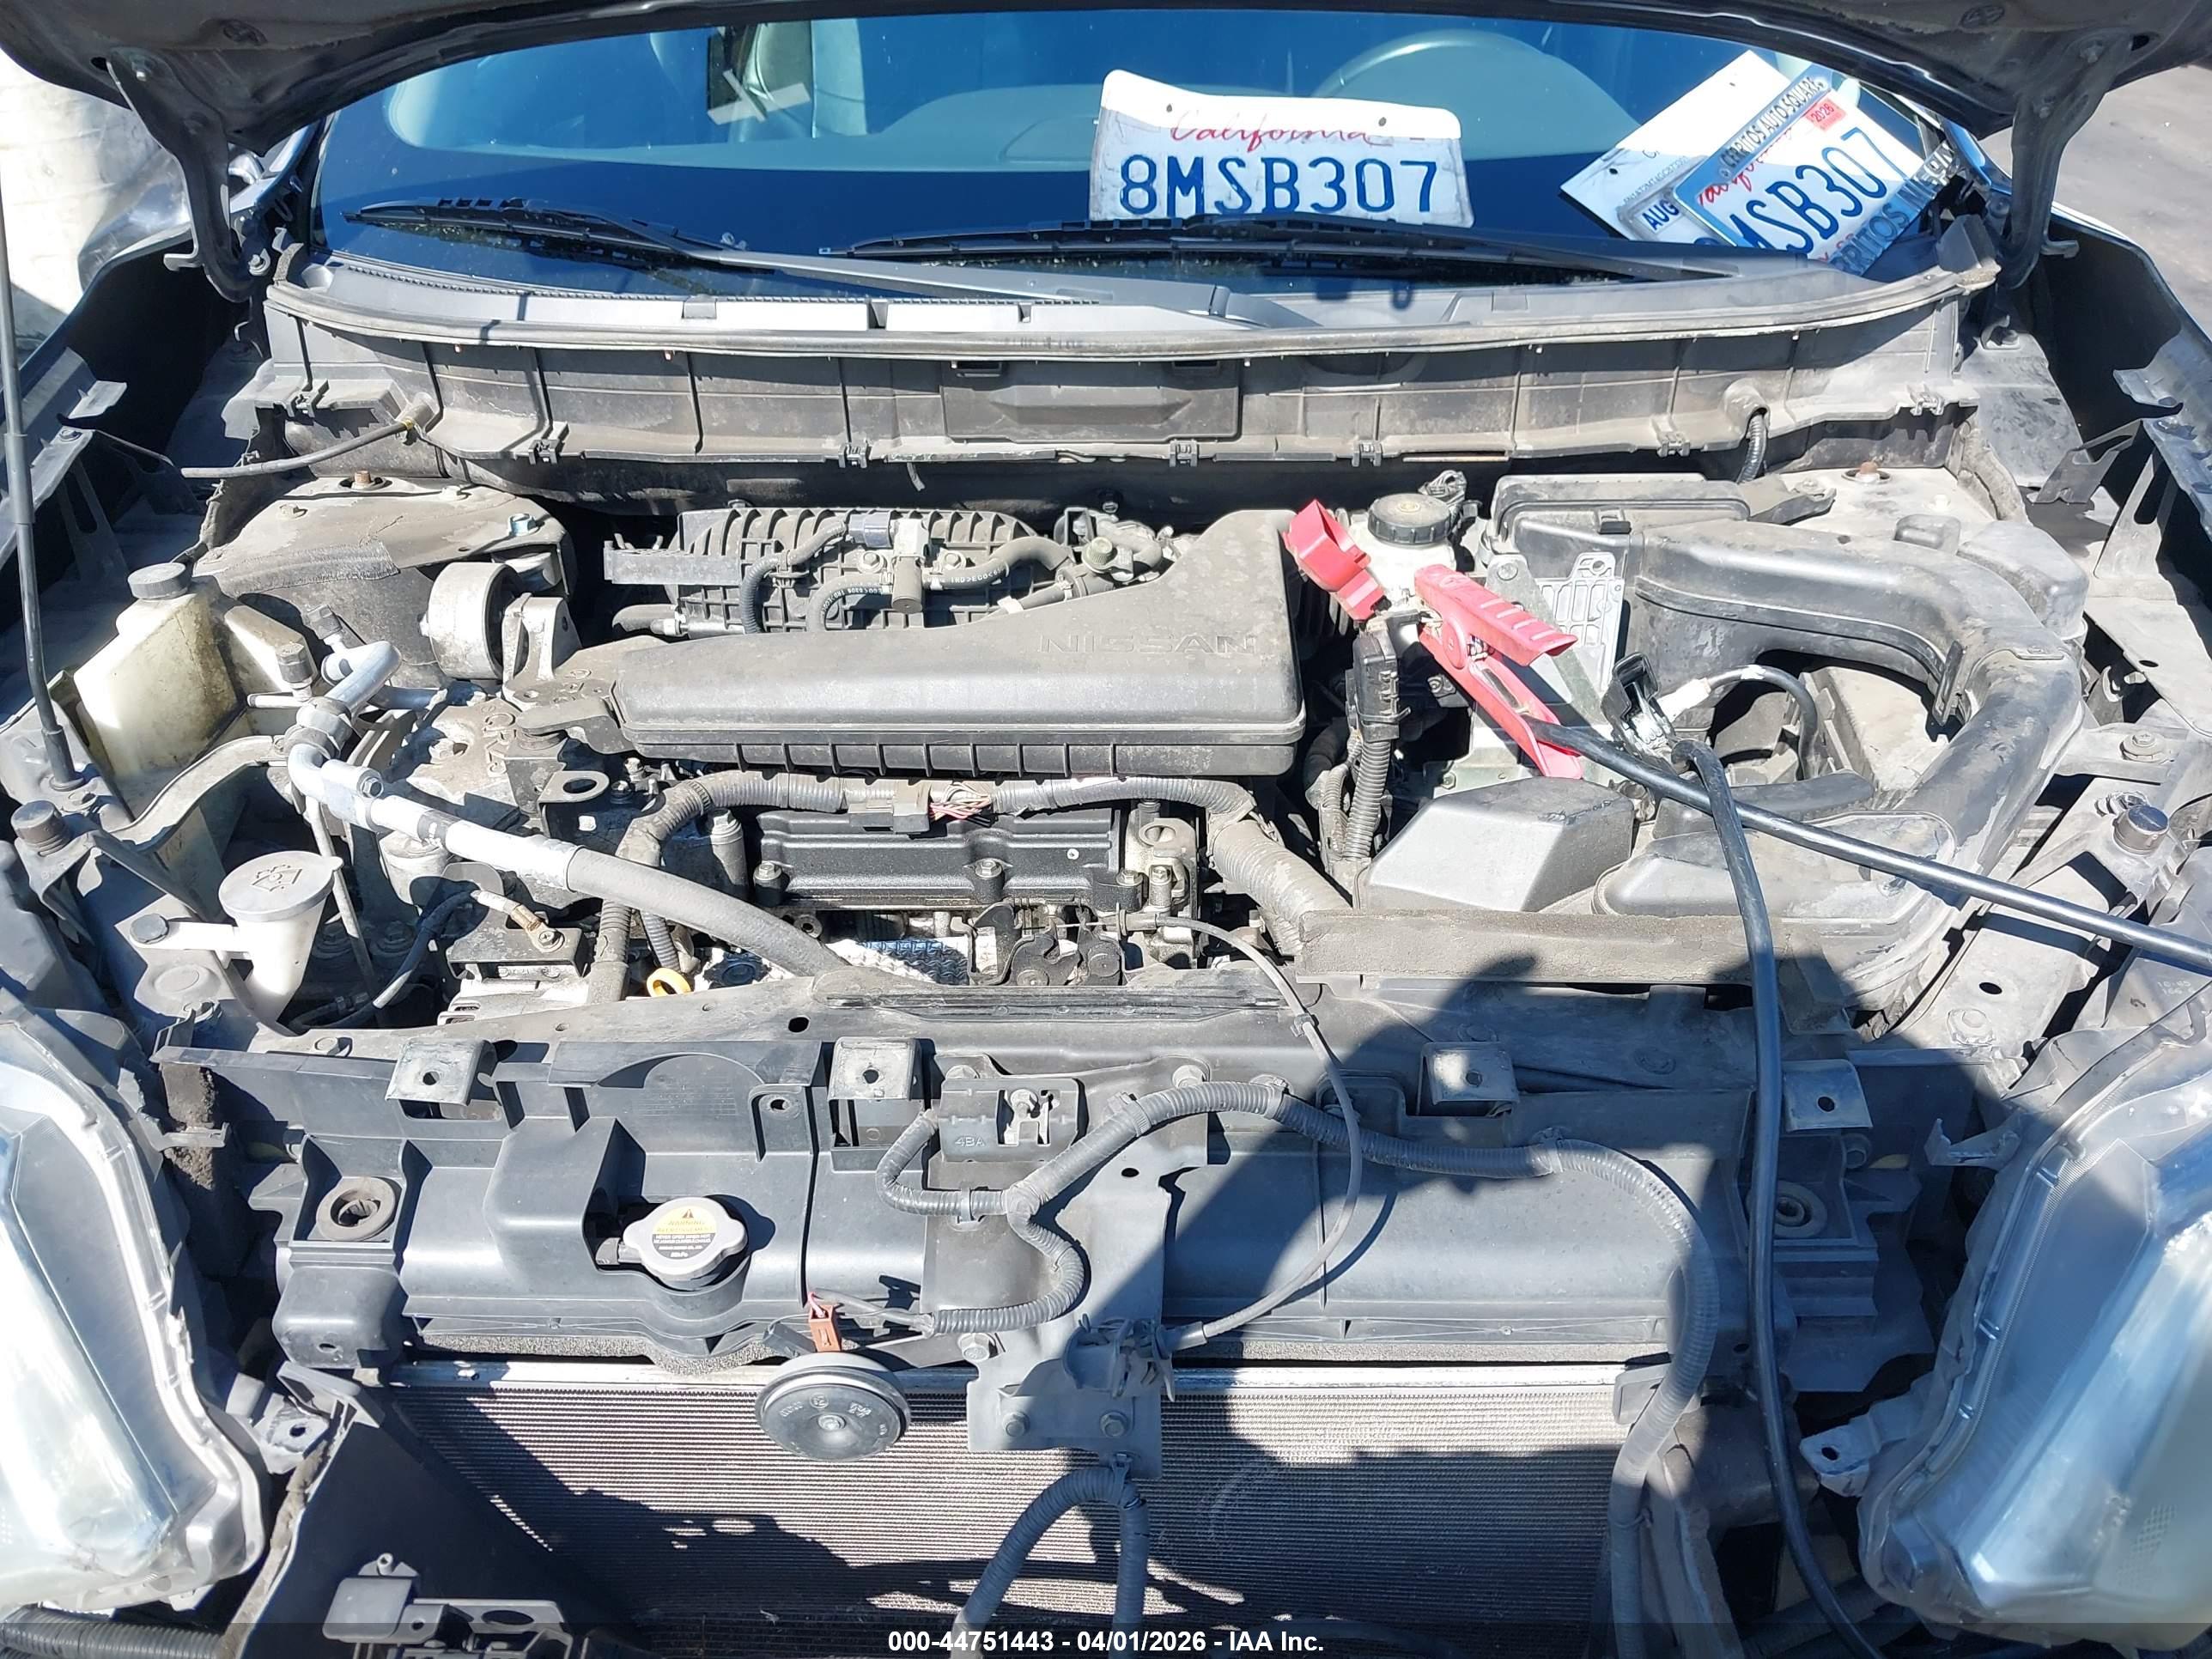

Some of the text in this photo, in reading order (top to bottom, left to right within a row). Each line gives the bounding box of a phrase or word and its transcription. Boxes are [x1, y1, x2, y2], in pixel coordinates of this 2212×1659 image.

[1171, 112, 1393, 153] California
[1720, 125, 1766, 168] CERRITOS
[1759, 104, 1790, 134] AUTO
[1781, 76, 1820, 113] SQUARE
[1121, 155, 1437, 216] 8MSB307
[1642, 199, 1680, 231] AUG
[1041, 635, 1258, 654] NISSAN
